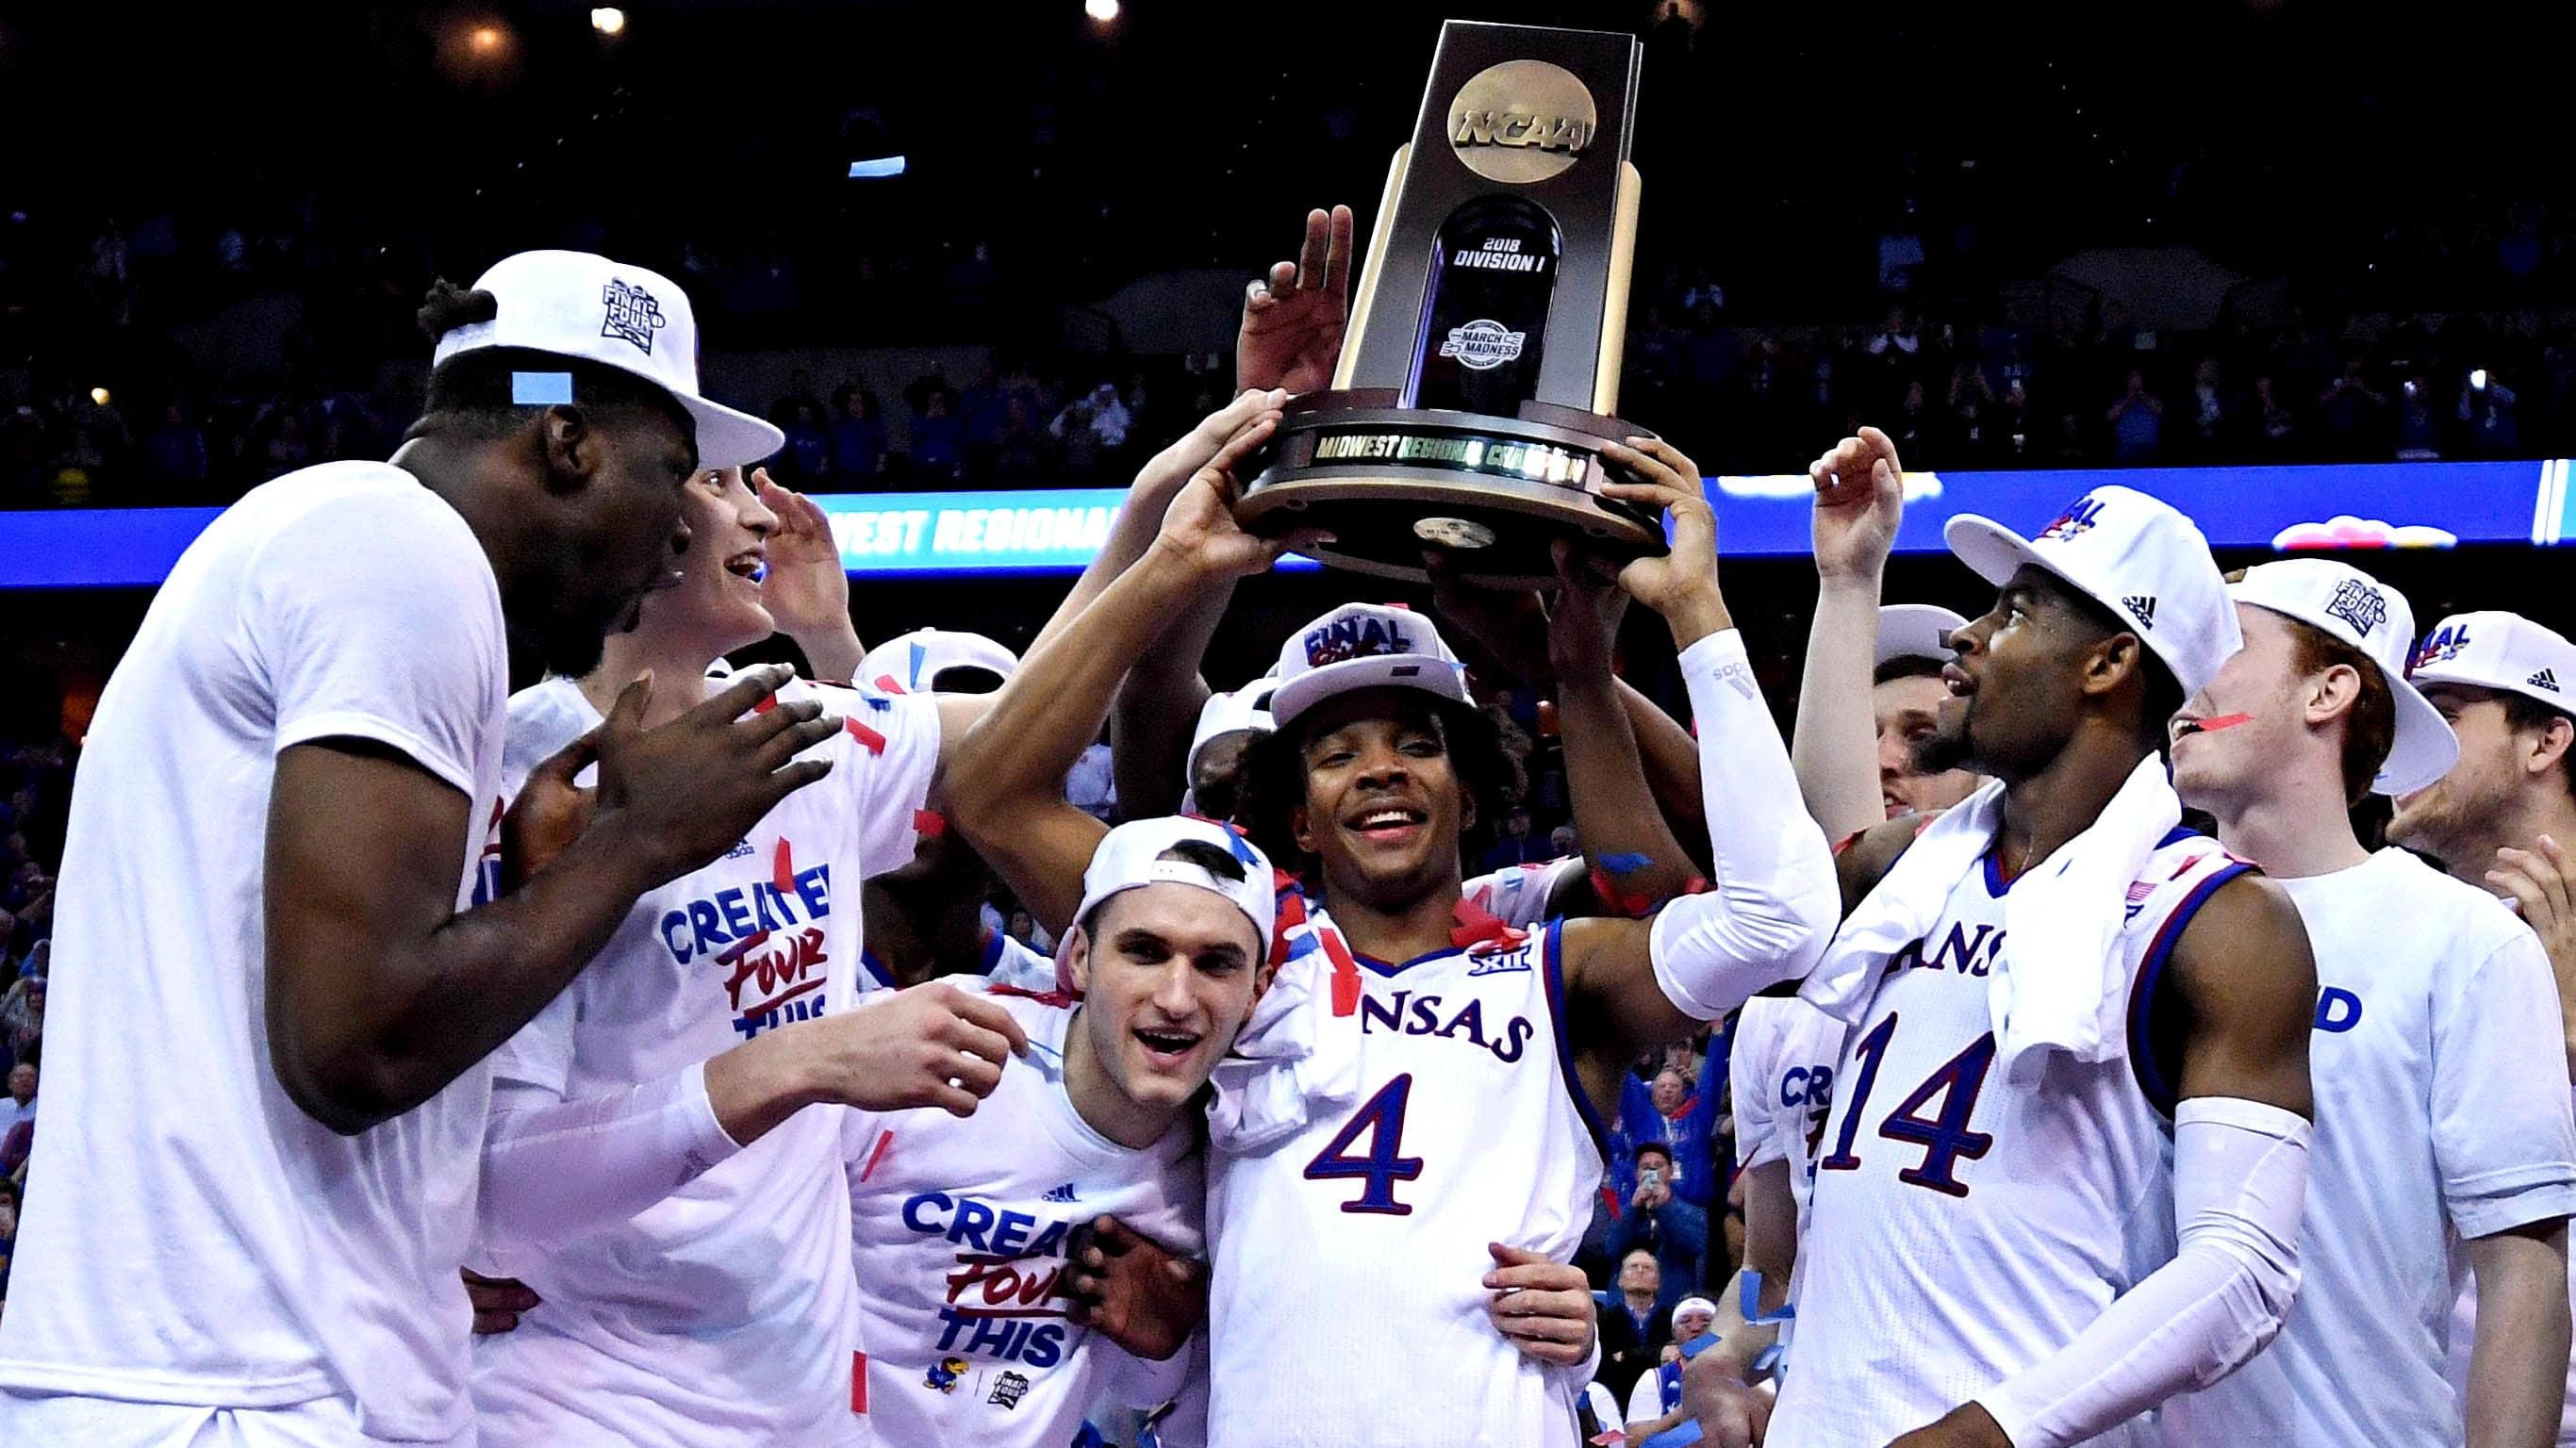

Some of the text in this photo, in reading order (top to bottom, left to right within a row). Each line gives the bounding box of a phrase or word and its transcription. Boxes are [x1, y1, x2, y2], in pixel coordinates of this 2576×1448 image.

[1455, 109, 1586, 154] NCAA
[1453, 250, 1546, 272] DIVISION I
[1482, 237, 1522, 253] 2018
[603, 285, 651, 317] FINAL
[607, 303, 652, 337] FOUR
[1461, 331, 1503, 344] MARCH
[1463, 341, 1520, 356] MADNESS
[1316, 435, 1399, 459] MIDWEST
[827, 511, 931, 554] WEST
[2337, 580, 2377, 614] FINAL
[2337, 592, 2375, 627] FOUR
[1304, 616, 1412, 666] FINAL
[661, 864, 831, 965] CREATE
[715, 927, 828, 1012] FOUR
[1361, 989, 1534, 1064] NSAS
[1821, 1011, 1994, 1198] 14
[1303, 1072, 1425, 1216] 4
[902, 1193, 1068, 1257] CREA
[946, 1253, 1064, 1307] FOU
[935, 1306, 1065, 1368] THIS
